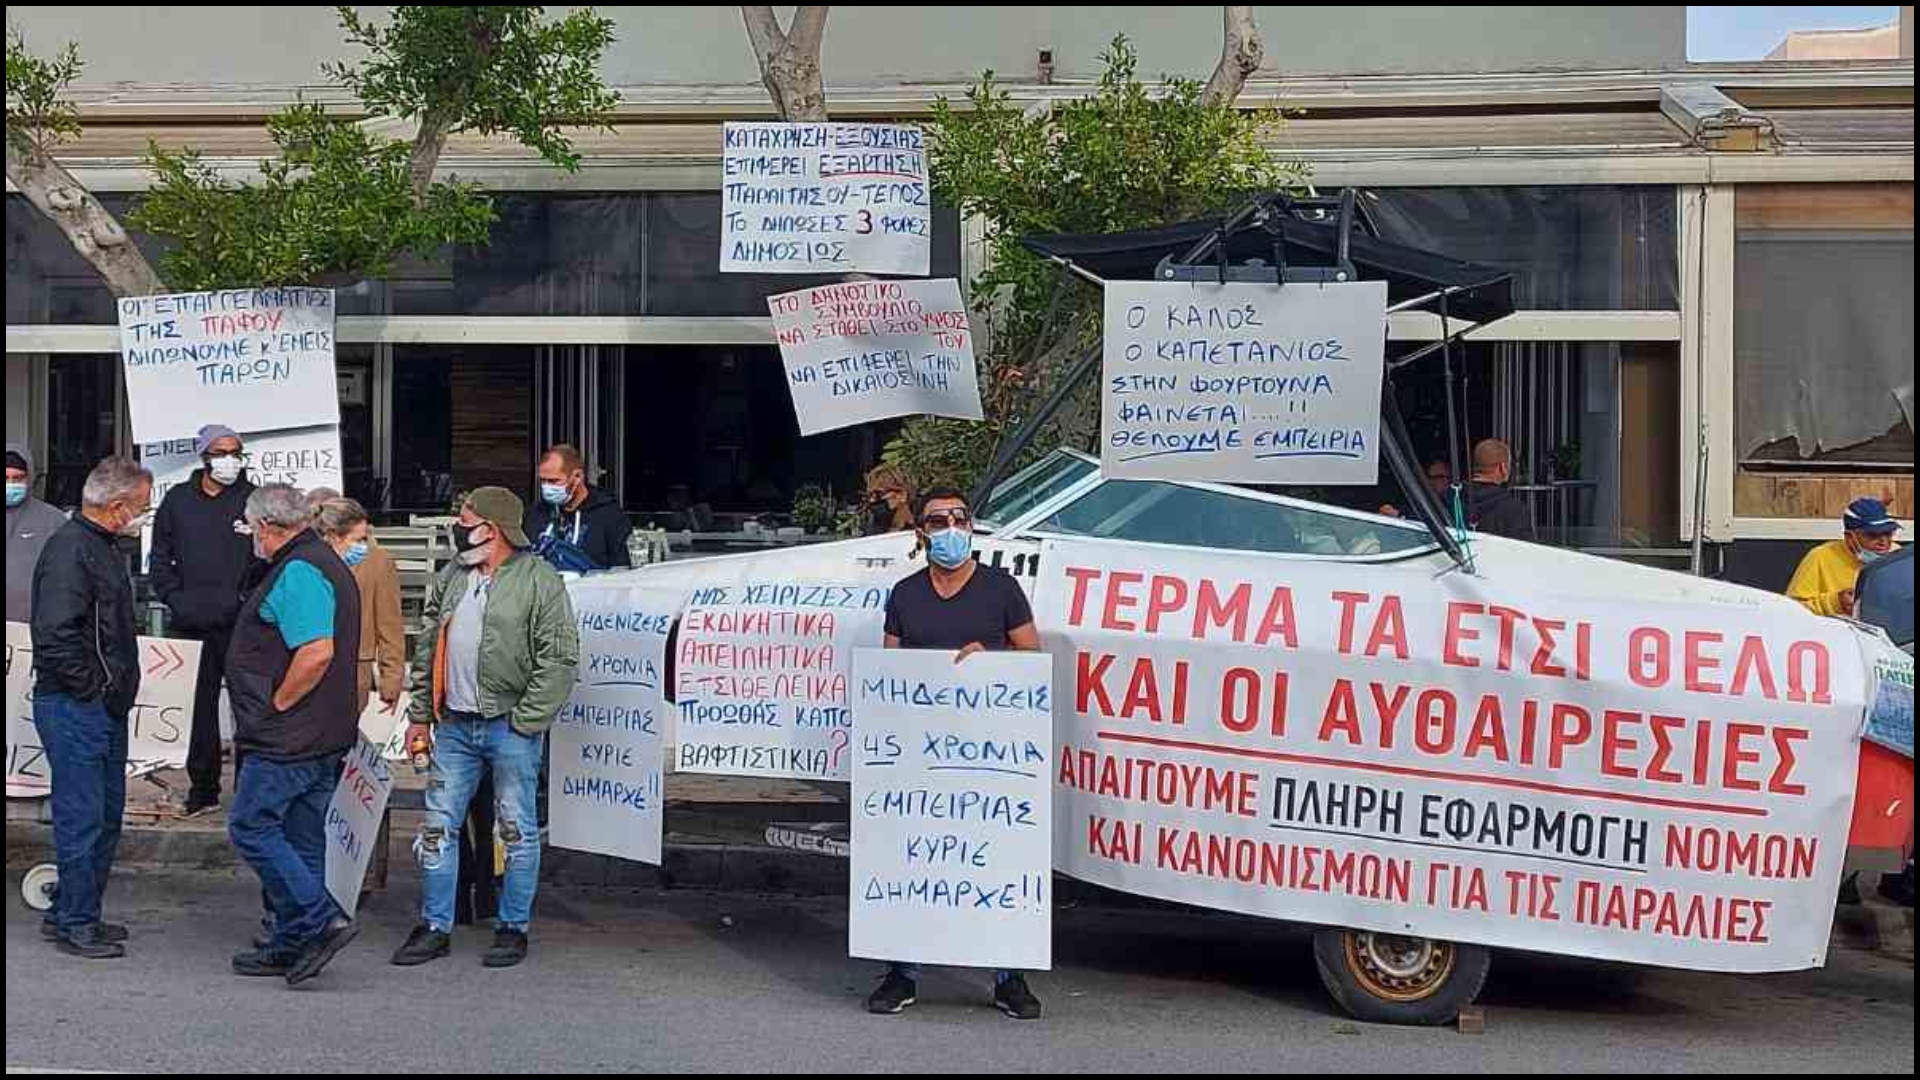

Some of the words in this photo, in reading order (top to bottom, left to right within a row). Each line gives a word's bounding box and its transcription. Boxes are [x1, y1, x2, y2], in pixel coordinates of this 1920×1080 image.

[726, 156, 807, 175] ΕΠΙΦΕΡΕΙ
[820, 154, 922, 175] ΕΞΑΡΤΗΣΗ
[856, 209, 873, 235] 3
[732, 240, 851, 262] ΔΗΜΟΣΙΩΣ
[773, 296, 798, 314] ΤΟ
[811, 284, 902, 306] ΔΗΜΟΤΙΚΟ
[818, 300, 922, 320] ΣΥΜΒΟΥΛΙΟ
[128, 320, 182, 342] ΤΗΣ
[201, 310, 283, 337] ΠΑΦΟΥ
[780, 328, 805, 345] ΝΑ
[884, 319, 918, 334] ΣΤΟ
[1127, 305, 1145, 329] Ο
[1167, 304, 1264, 330] ΚΑΛΟΣ
[933, 331, 963, 349] ΤΟΥ
[1125, 345, 1142, 362] Ο
[196, 357, 290, 384] ΠΑΡΩΝ
[791, 369, 815, 385] ΝΑ
[823, 349, 914, 378] ΕΠΙΦΕΡΕΙ
[921, 354, 960, 372] ΤΗΝ
[1112, 374, 1177, 394] ΣΤΗΝ
[1190, 374, 1333, 395] ΦΟΥΡΤΟΥΝΑ
[1111, 430, 1242, 451] ΘΕΛΟΥΜΕ
[1254, 430, 1366, 451] ΕΜΠΕΙΡΙΑ
[577, 613, 669, 636] ΗΔΕΝΙΖΕΙΣ
[687, 608, 834, 639] ΕΚΔΙΚΗΤΙΚΑ
[1065, 567, 1299, 649] ΤΕΡΜΑ
[1332, 591, 1410, 660] ΤΑ
[1443, 601, 1592, 681] ΕΤΣΙ
[1627, 626, 1832, 705] ΘΕΛΩ
[589, 652, 658, 681] ΧΡΟΝΙΑ
[681, 638, 834, 670] ΑΠΕΙΛΗΤΙΚΑ
[680, 673, 847, 704] ΕΤΣΙΘΕΛΕΙΚΑ
[861, 675, 1051, 713] ΜΗΔΕΝΙΖΕΙΣ
[1075, 652, 1189, 725] ΚΑΙ
[1220, 667, 1289, 737] ΟΙ
[1317, 678, 1810, 796] ΑΥΘΑΙΡΕΣΙΕΣ
[582, 744, 633, 768] ΚΥΡΙΕ
[863, 735, 902, 757] 45
[923, 731, 1045, 764] ΧΡΟΝΙΑ
[863, 790, 1037, 827] ΕΜΠΕΙΡΙΑΣ
[1058, 746, 1259, 818] ΑΠΑΙΤΟΥΜΕ
[1272, 776, 1405, 835] ΠΛΗΡΗ
[1419, 793, 1649, 865] ΕΦΑΡΜΟΓΗ
[1664, 823, 1818, 879] ΝΟΜΩΝ
[906, 835, 991, 867] ΚΥΡΙΕ
[864, 874, 1043, 914] ΔΗΜΑΡΧΕ!!
[1087, 814, 1142, 866] ΚΑΙ
[1157, 826, 1412, 903] ΚΑΝΟΝΙΣΜΩΝ
[1427, 862, 1490, 913] ΓΙΑ
[1506, 870, 1561, 921] ΤΙΣ
[1575, 880, 1774, 944] ΠΑΡΑΛΙΕΣ
